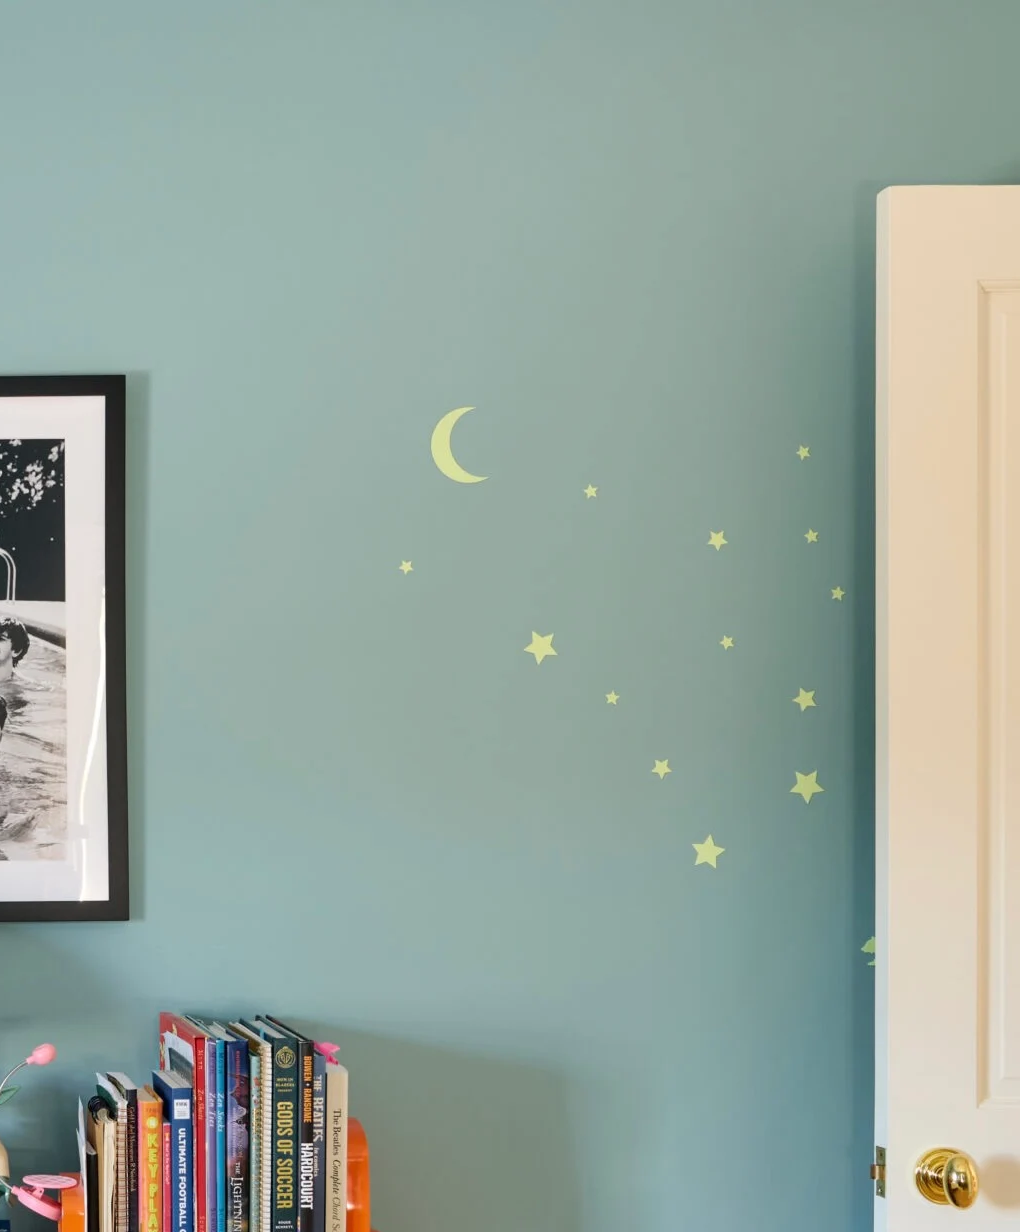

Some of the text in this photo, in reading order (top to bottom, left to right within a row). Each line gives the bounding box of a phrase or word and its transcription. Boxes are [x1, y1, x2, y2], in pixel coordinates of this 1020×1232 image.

[304, 1056, 312, 1123] BOWEN RANSOME
[313, 1075, 323, 1141] THE BEATLES
[277, 1102, 293, 1130] GODS
[333, 1109, 341, 1124] The
[148, 1134, 158, 1178] KEY
[277, 1133, 293, 1154] OF
[333, 1126, 341, 1155] Beatles
[277, 1158, 293, 1208] SOCCER
[301, 1143, 313, 1209] HARDCOURT
[331, 1159, 341, 1194] Complete
[179, 1176, 187, 1226] FOOTBALL
[332, 1197, 341, 1220] Chord
